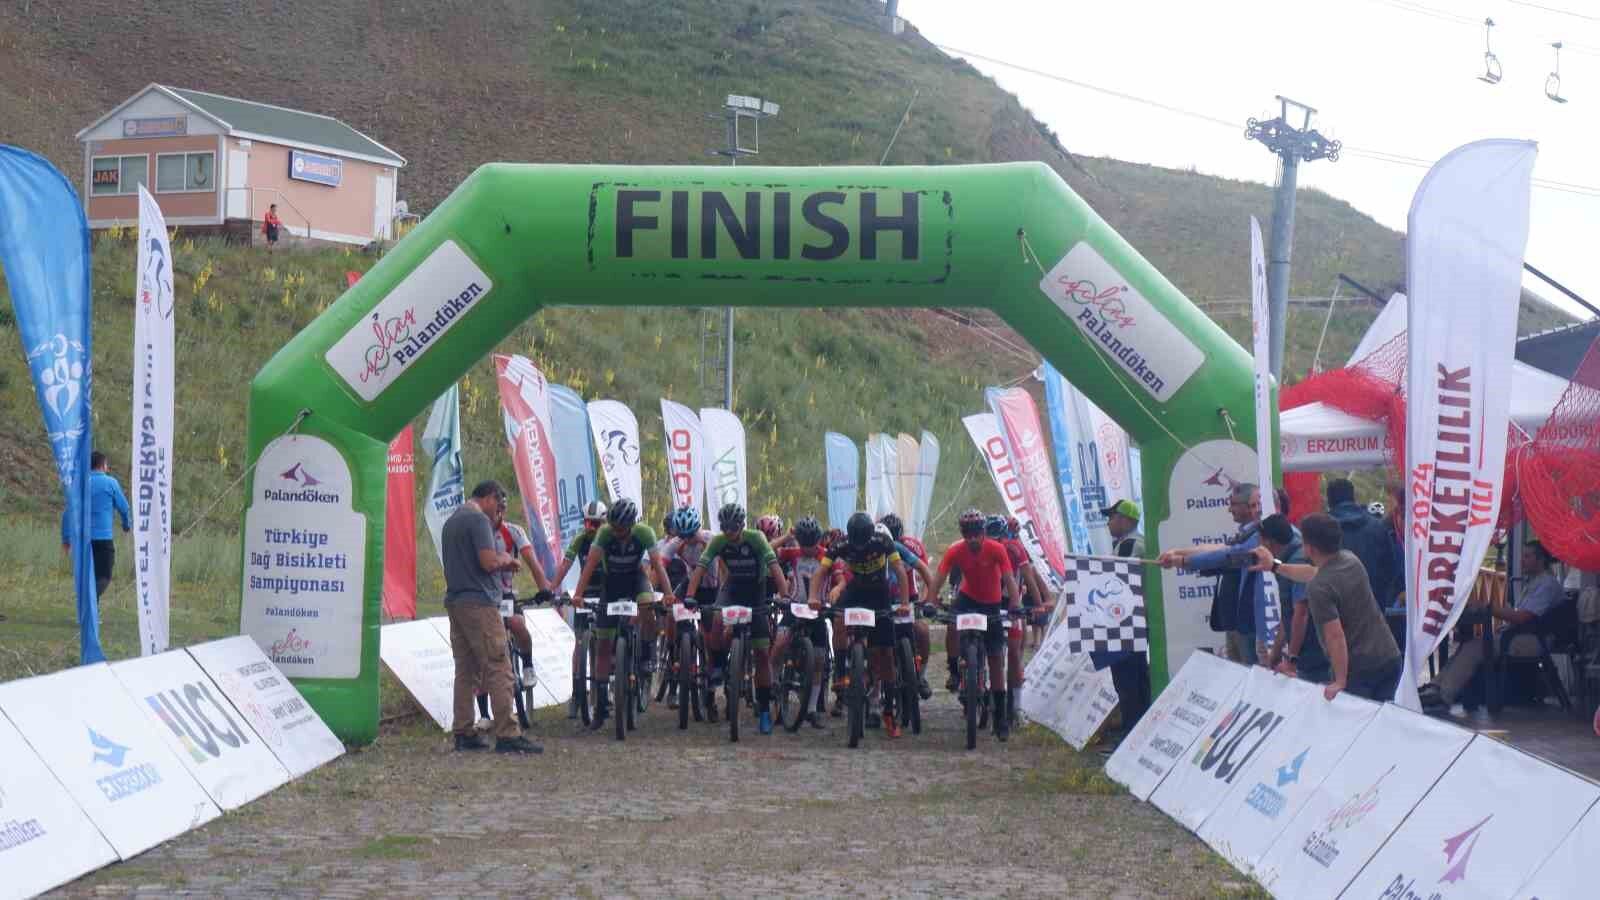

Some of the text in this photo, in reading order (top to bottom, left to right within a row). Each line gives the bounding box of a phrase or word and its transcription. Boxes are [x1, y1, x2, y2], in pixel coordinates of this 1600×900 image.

[614, 190, 919, 261] FINISH
[393, 282, 483, 366] Palandöken
[1077, 307, 1166, 394] Palandöken
[1306, 437, 1378, 453] ERZURUM
[264, 488, 339, 504] Palandöken
[1411, 463, 1434, 541] 2024
[1468, 479, 1493, 528] YILI
[251, 549, 346, 570] Dağ Bisikleti
[264, 528, 328, 548] Türkiye
[156, 681, 251, 759] UCI
[1200, 702, 1285, 785] UCI
